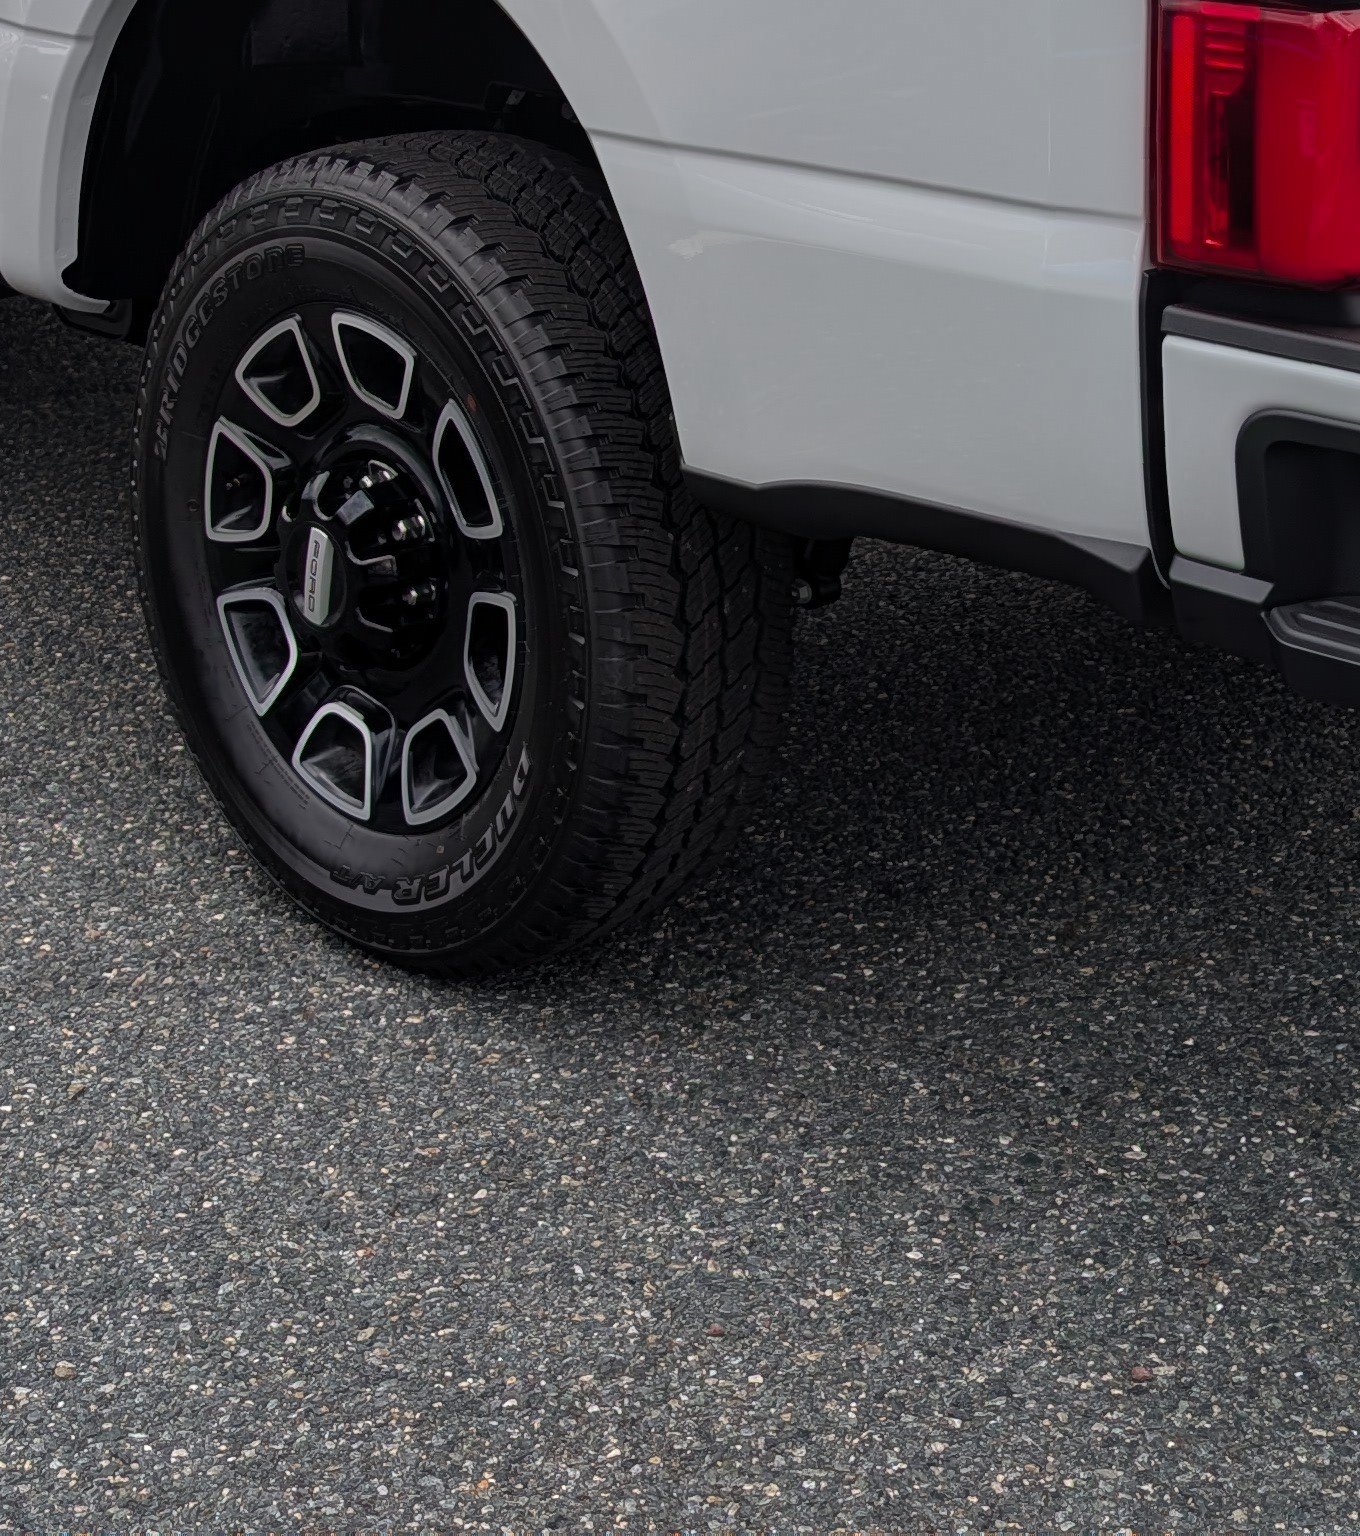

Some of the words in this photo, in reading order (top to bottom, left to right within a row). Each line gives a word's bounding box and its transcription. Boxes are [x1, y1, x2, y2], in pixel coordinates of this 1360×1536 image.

[153, 242, 306, 461] BRIDGESTONE
[308, 539, 321, 613] FORD
[391, 740, 533, 906] DUELER
